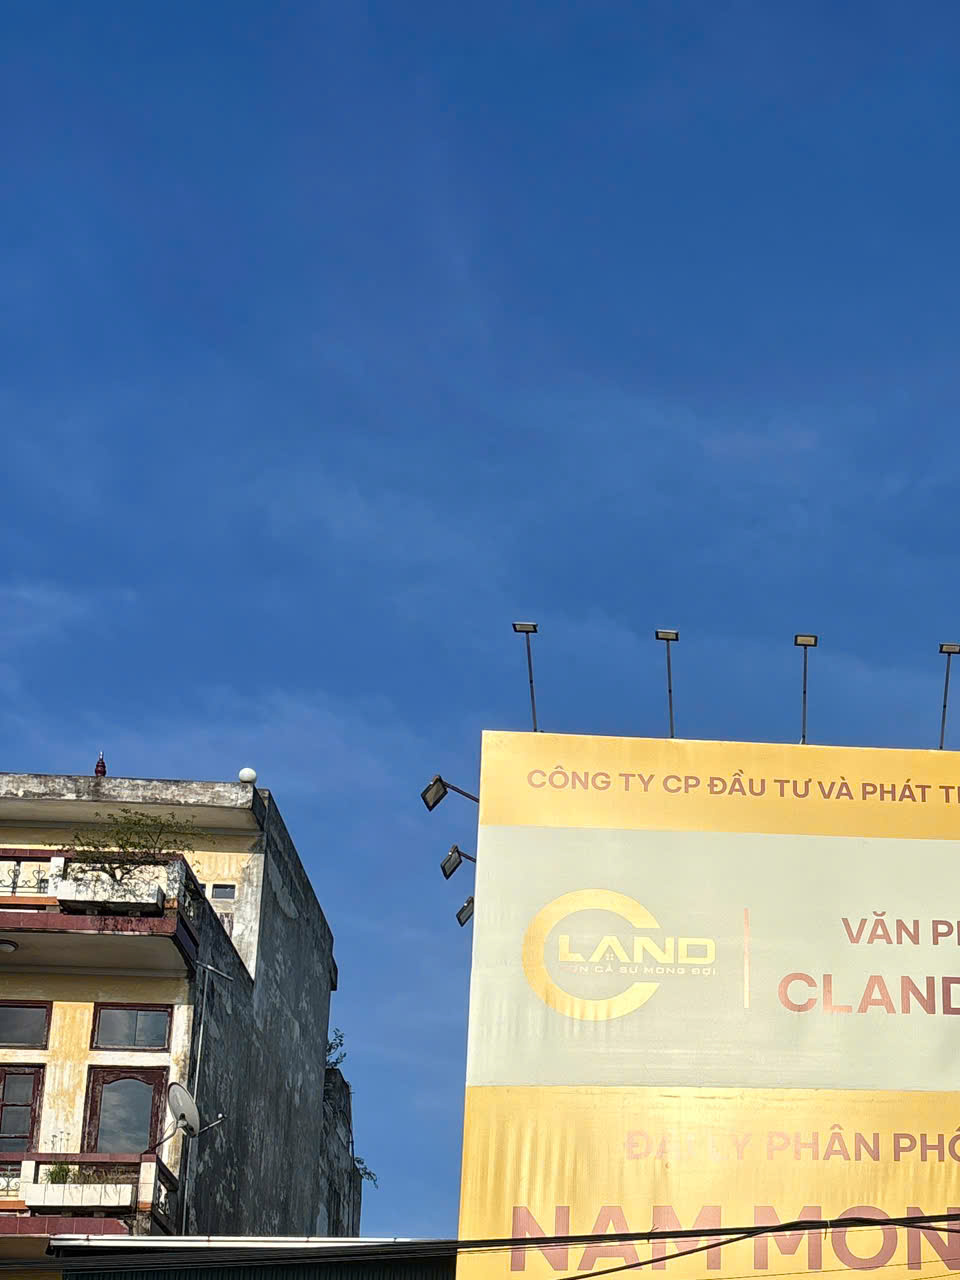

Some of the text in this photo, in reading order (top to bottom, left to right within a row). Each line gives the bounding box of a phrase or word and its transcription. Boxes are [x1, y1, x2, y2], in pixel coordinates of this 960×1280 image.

[527, 765, 611, 791] CÔNG
[619, 773, 655, 792] TY
[663, 775, 701, 793] CP
[707, 769, 765, 797] ĐẦU
[774, 778, 812, 799] TƯ
[817, 776, 854, 800] VÀ
[862, 779, 932, 803] PHÁT
[841, 911, 919, 946] VĂN
[766, 1123, 880, 1162] PHÂN
[510, 1205, 722, 1272] NAM
